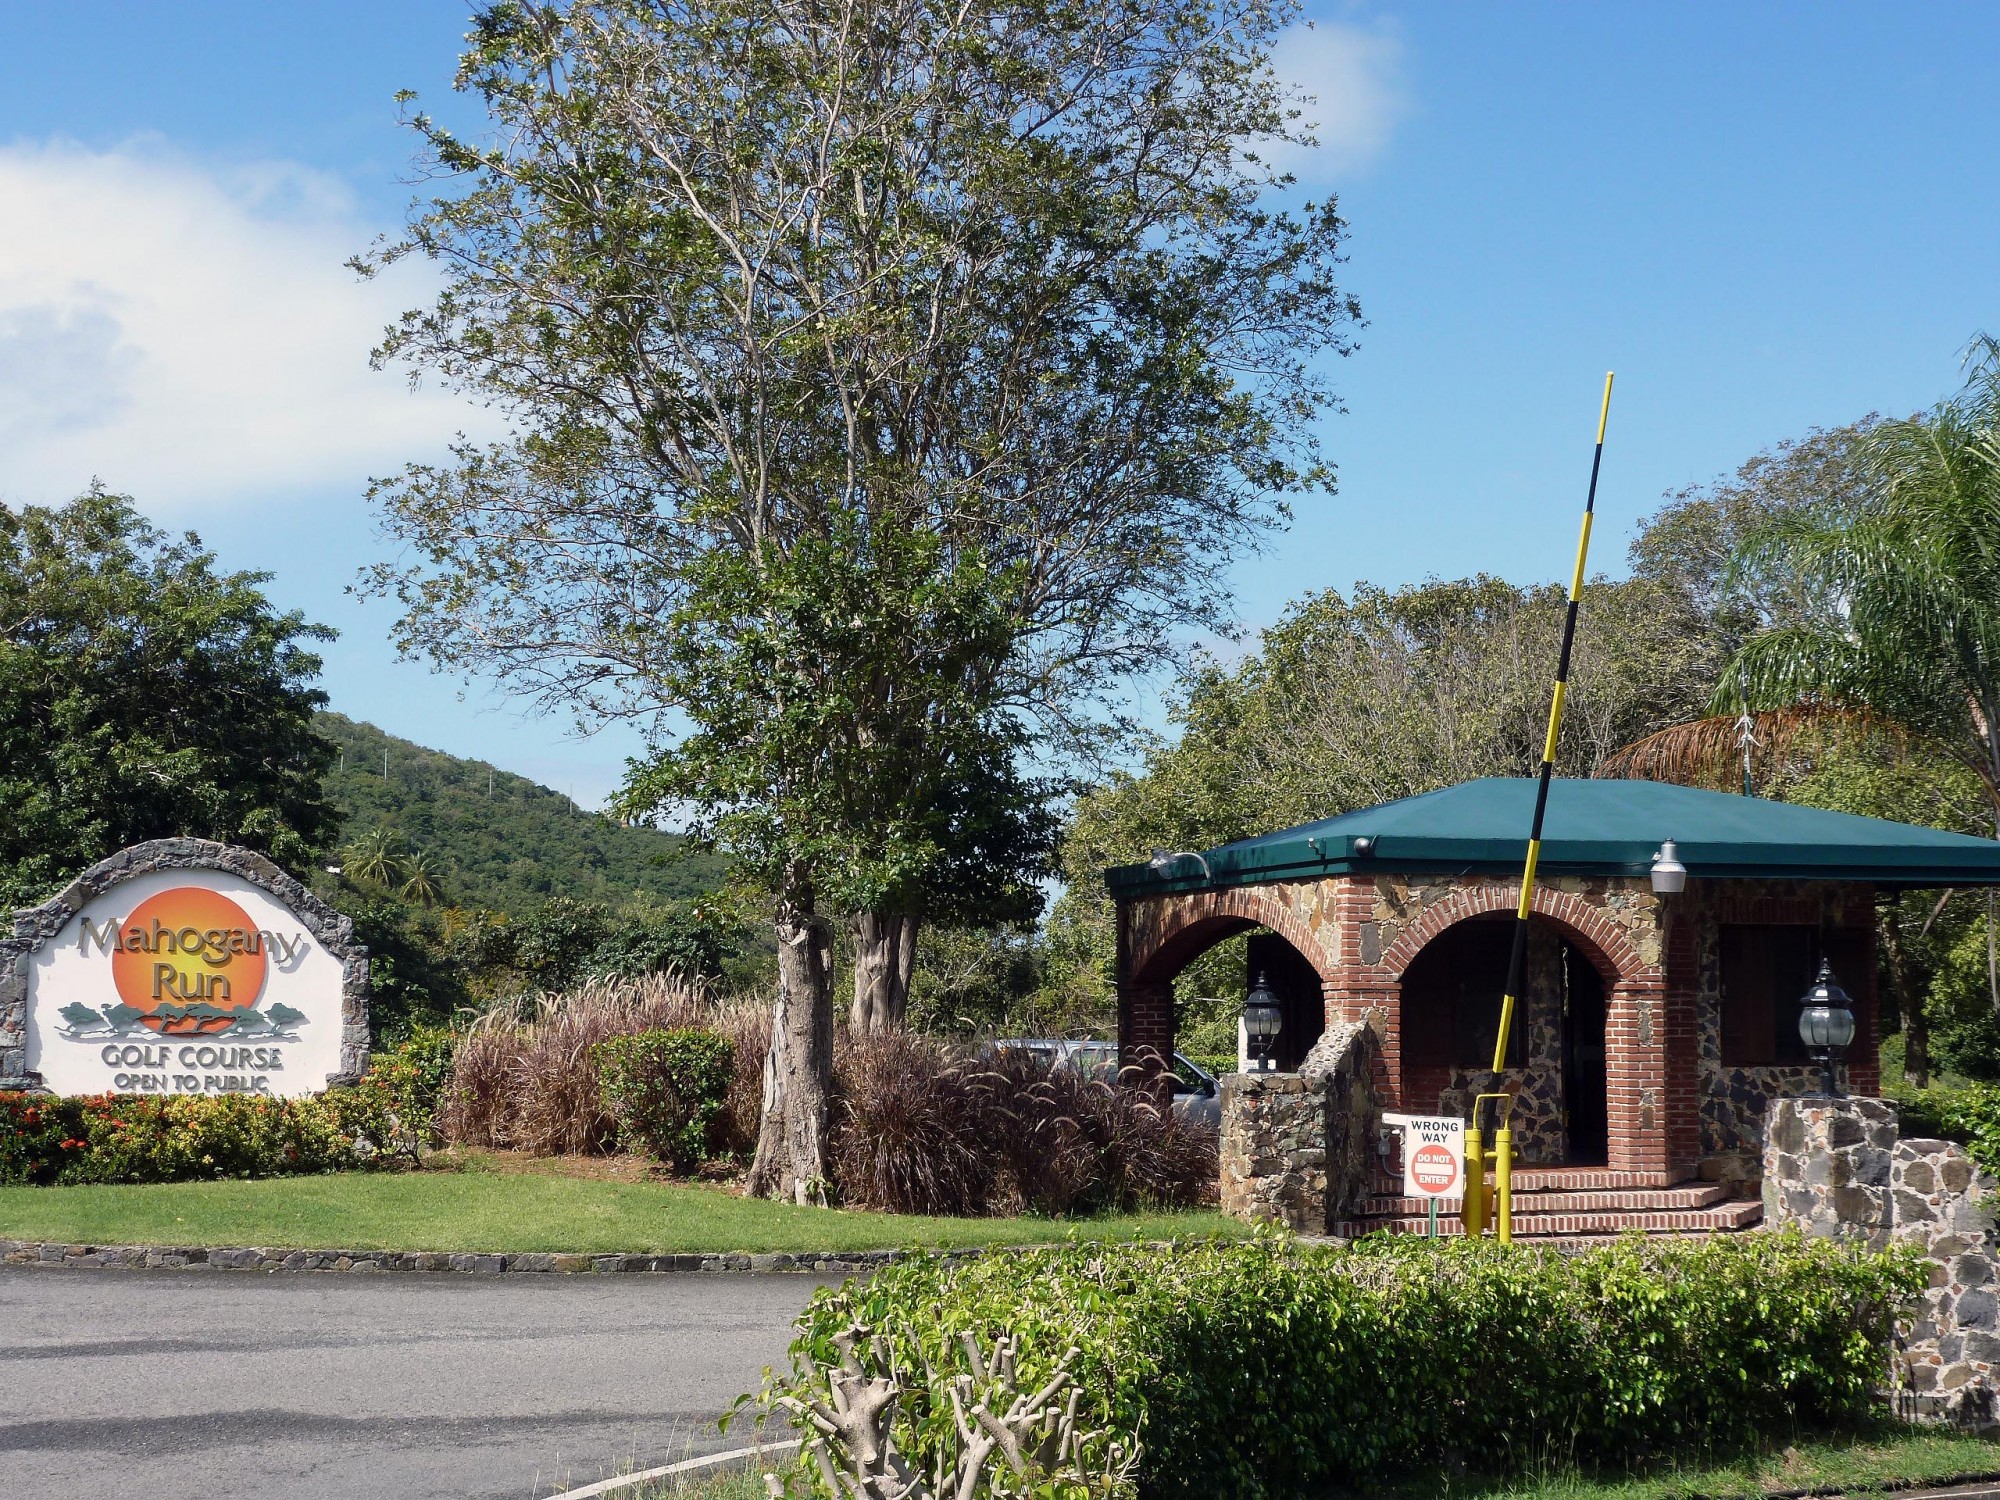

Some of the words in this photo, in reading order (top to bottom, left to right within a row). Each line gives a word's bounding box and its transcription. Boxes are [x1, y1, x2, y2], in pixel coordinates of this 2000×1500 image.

[77, 917, 303, 965] Mahogany
[152, 963, 231, 1000] Run
[101, 1045, 170, 1067] GOLF
[178, 1046, 283, 1069] COURSE
[114, 1073, 167, 1090] OPEN
[172, 1075, 199, 1090] TO
[204, 1075, 268, 1091] PUBLIC
[1411, 1120, 1459, 1132] WRONG
[1421, 1132, 1448, 1143] WAY
[1417, 1154, 1430, 1163] DO
[1432, 1154, 1451, 1164] NOT
[1419, 1175, 1449, 1185] ENTER
